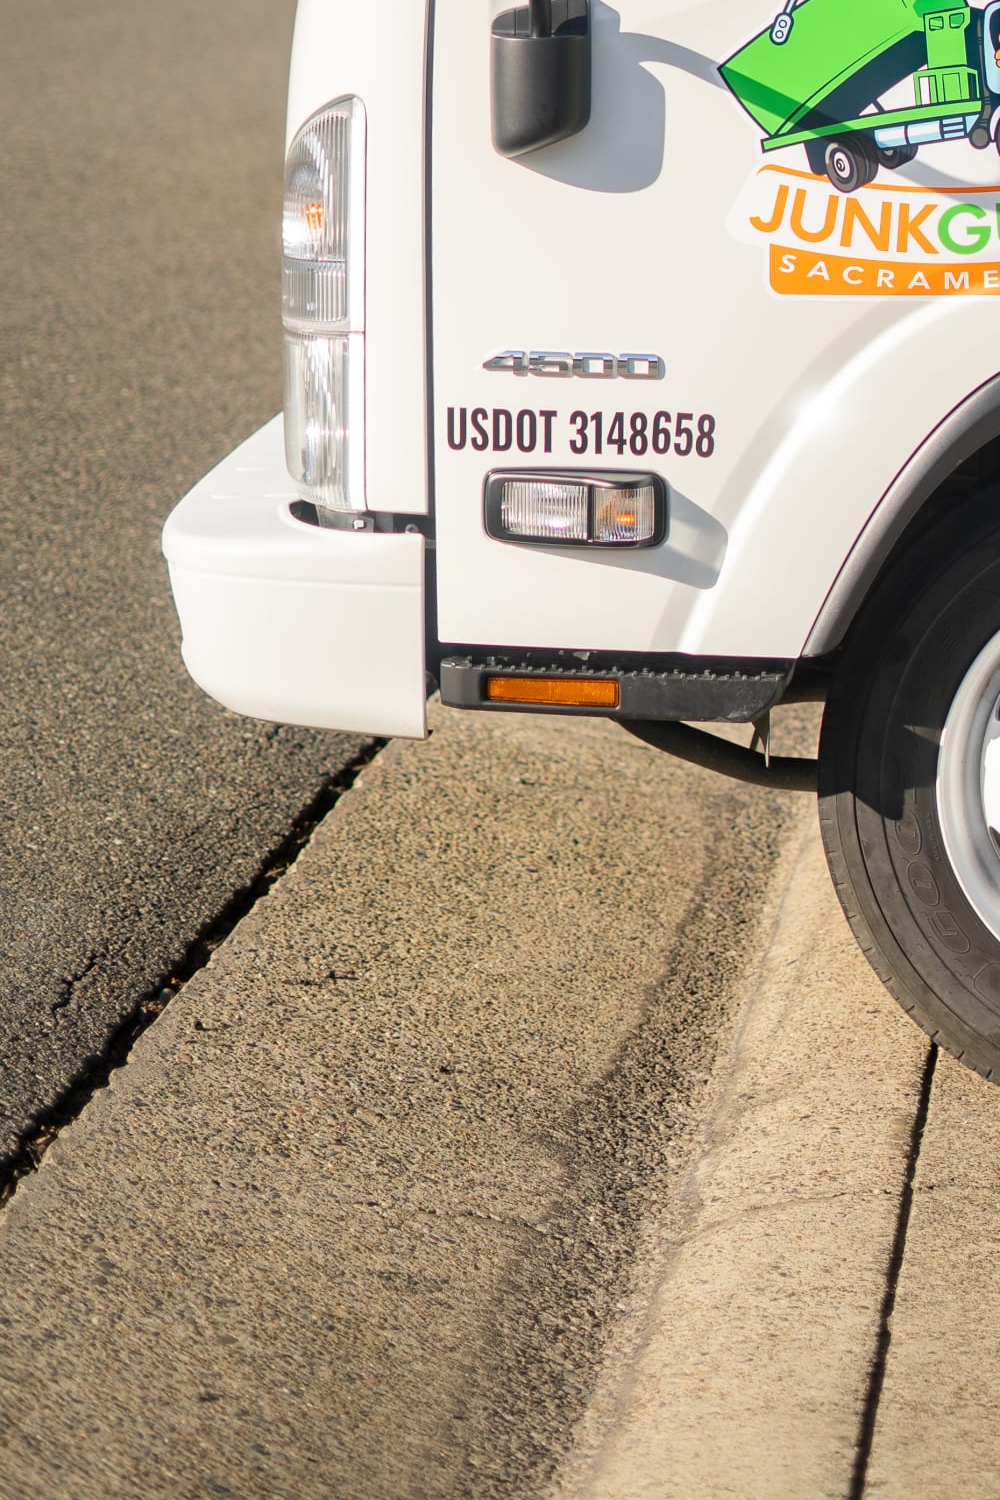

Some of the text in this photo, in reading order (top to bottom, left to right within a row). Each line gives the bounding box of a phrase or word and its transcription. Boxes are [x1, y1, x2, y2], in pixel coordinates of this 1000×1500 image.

[483, 350, 664, 379] 4500
[447, 407, 716, 458] USDOT 3148658
